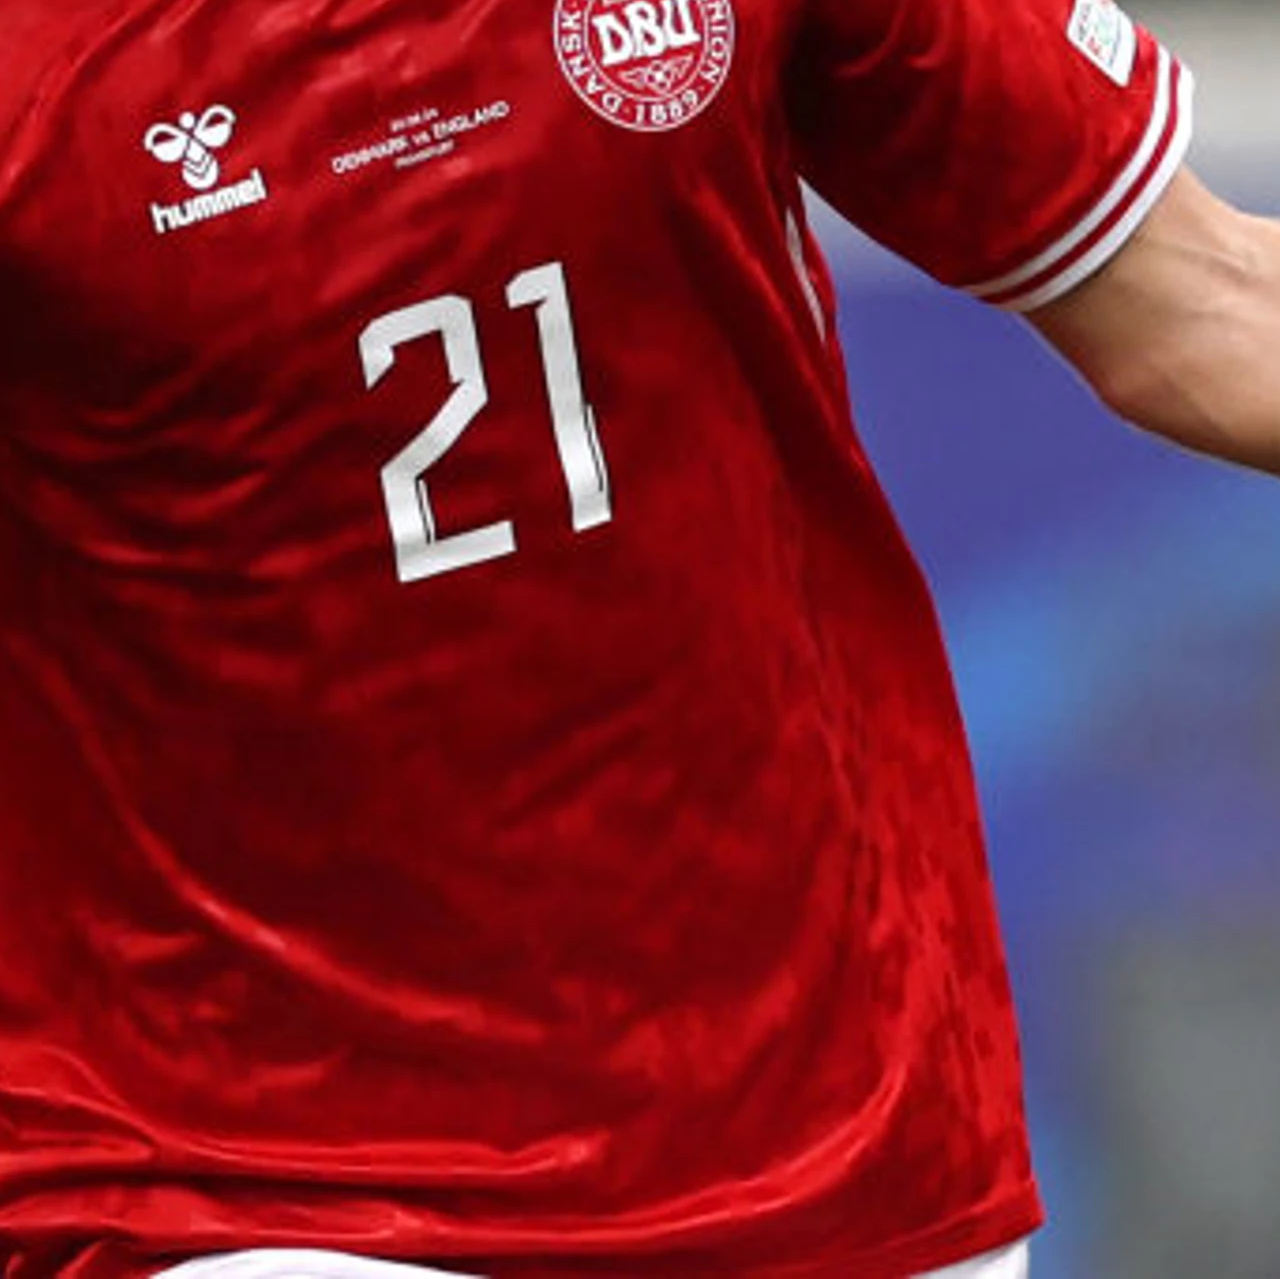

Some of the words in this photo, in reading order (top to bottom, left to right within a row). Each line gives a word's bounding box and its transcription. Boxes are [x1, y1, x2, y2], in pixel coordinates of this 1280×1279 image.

[561, 10, 622, 114] DANSK
[431, 100, 510, 140] ENGLAND
[149, 167, 268, 234] hummel
[358, 261, 612, 583] 21
